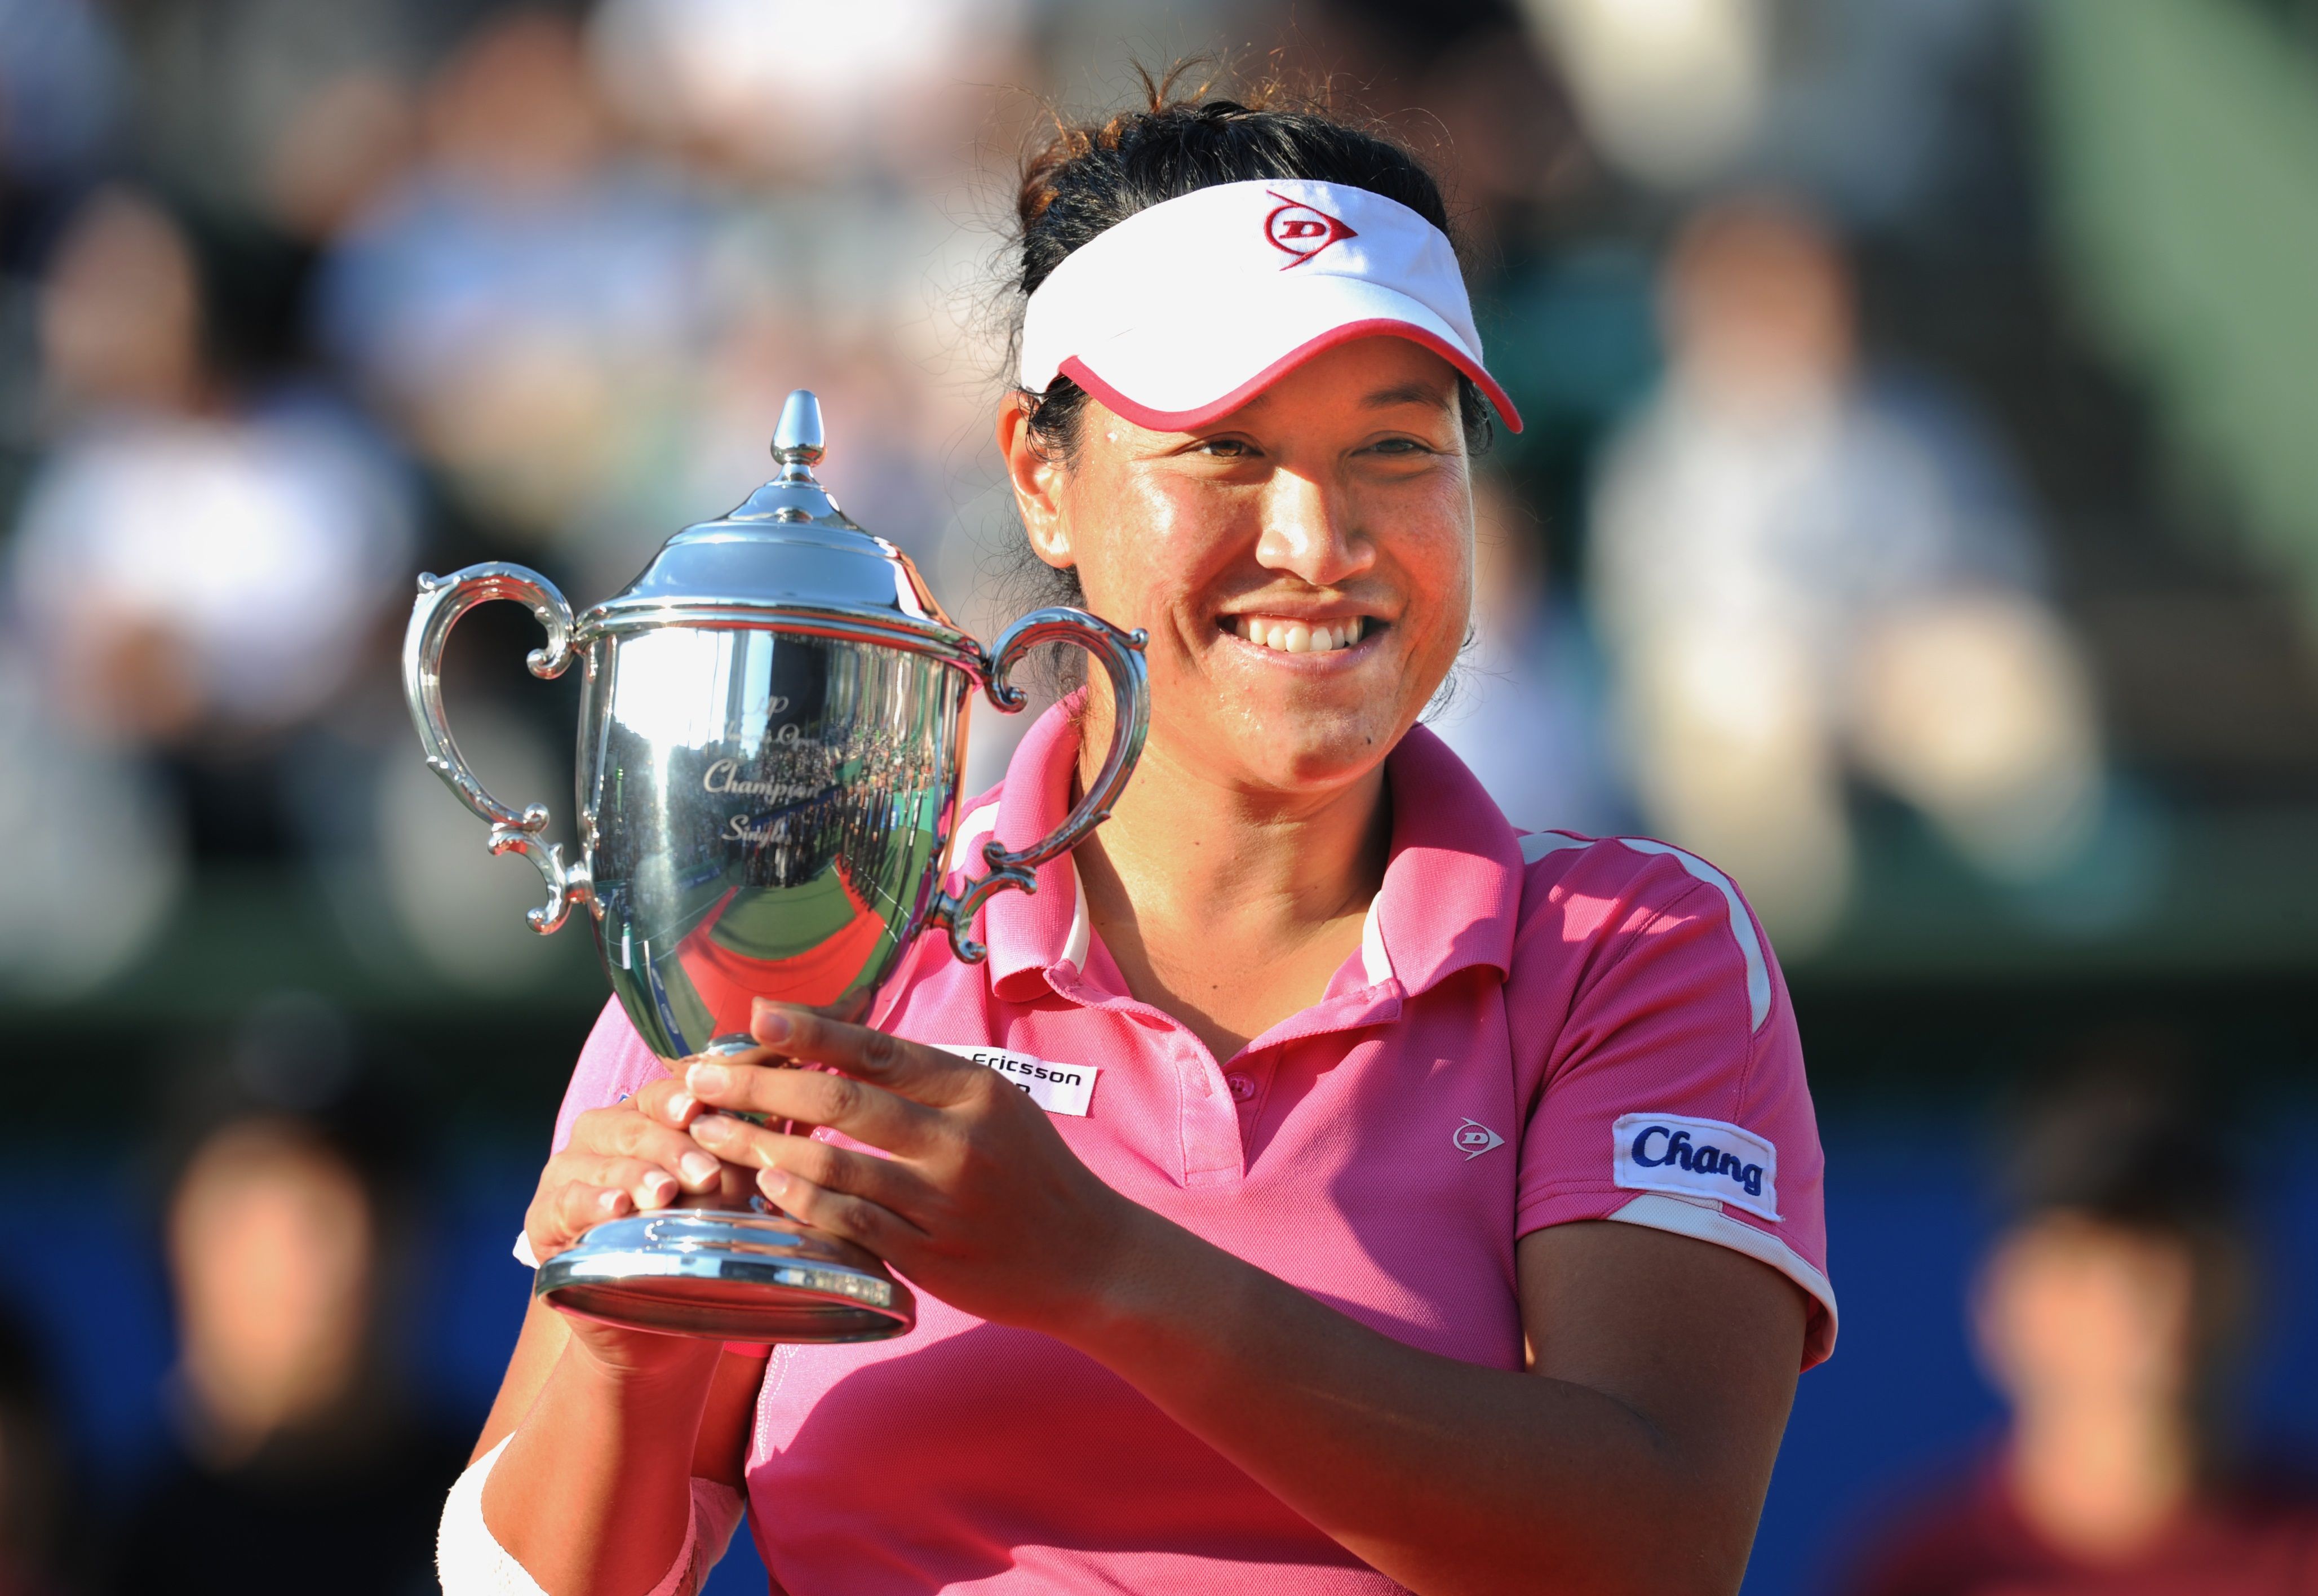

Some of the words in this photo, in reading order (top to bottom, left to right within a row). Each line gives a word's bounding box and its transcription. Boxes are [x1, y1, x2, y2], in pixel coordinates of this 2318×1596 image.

[1279, 220, 1327, 240] D
[1461, 1132, 1489, 1144] D
[1632, 1125, 1763, 1196] Chang
